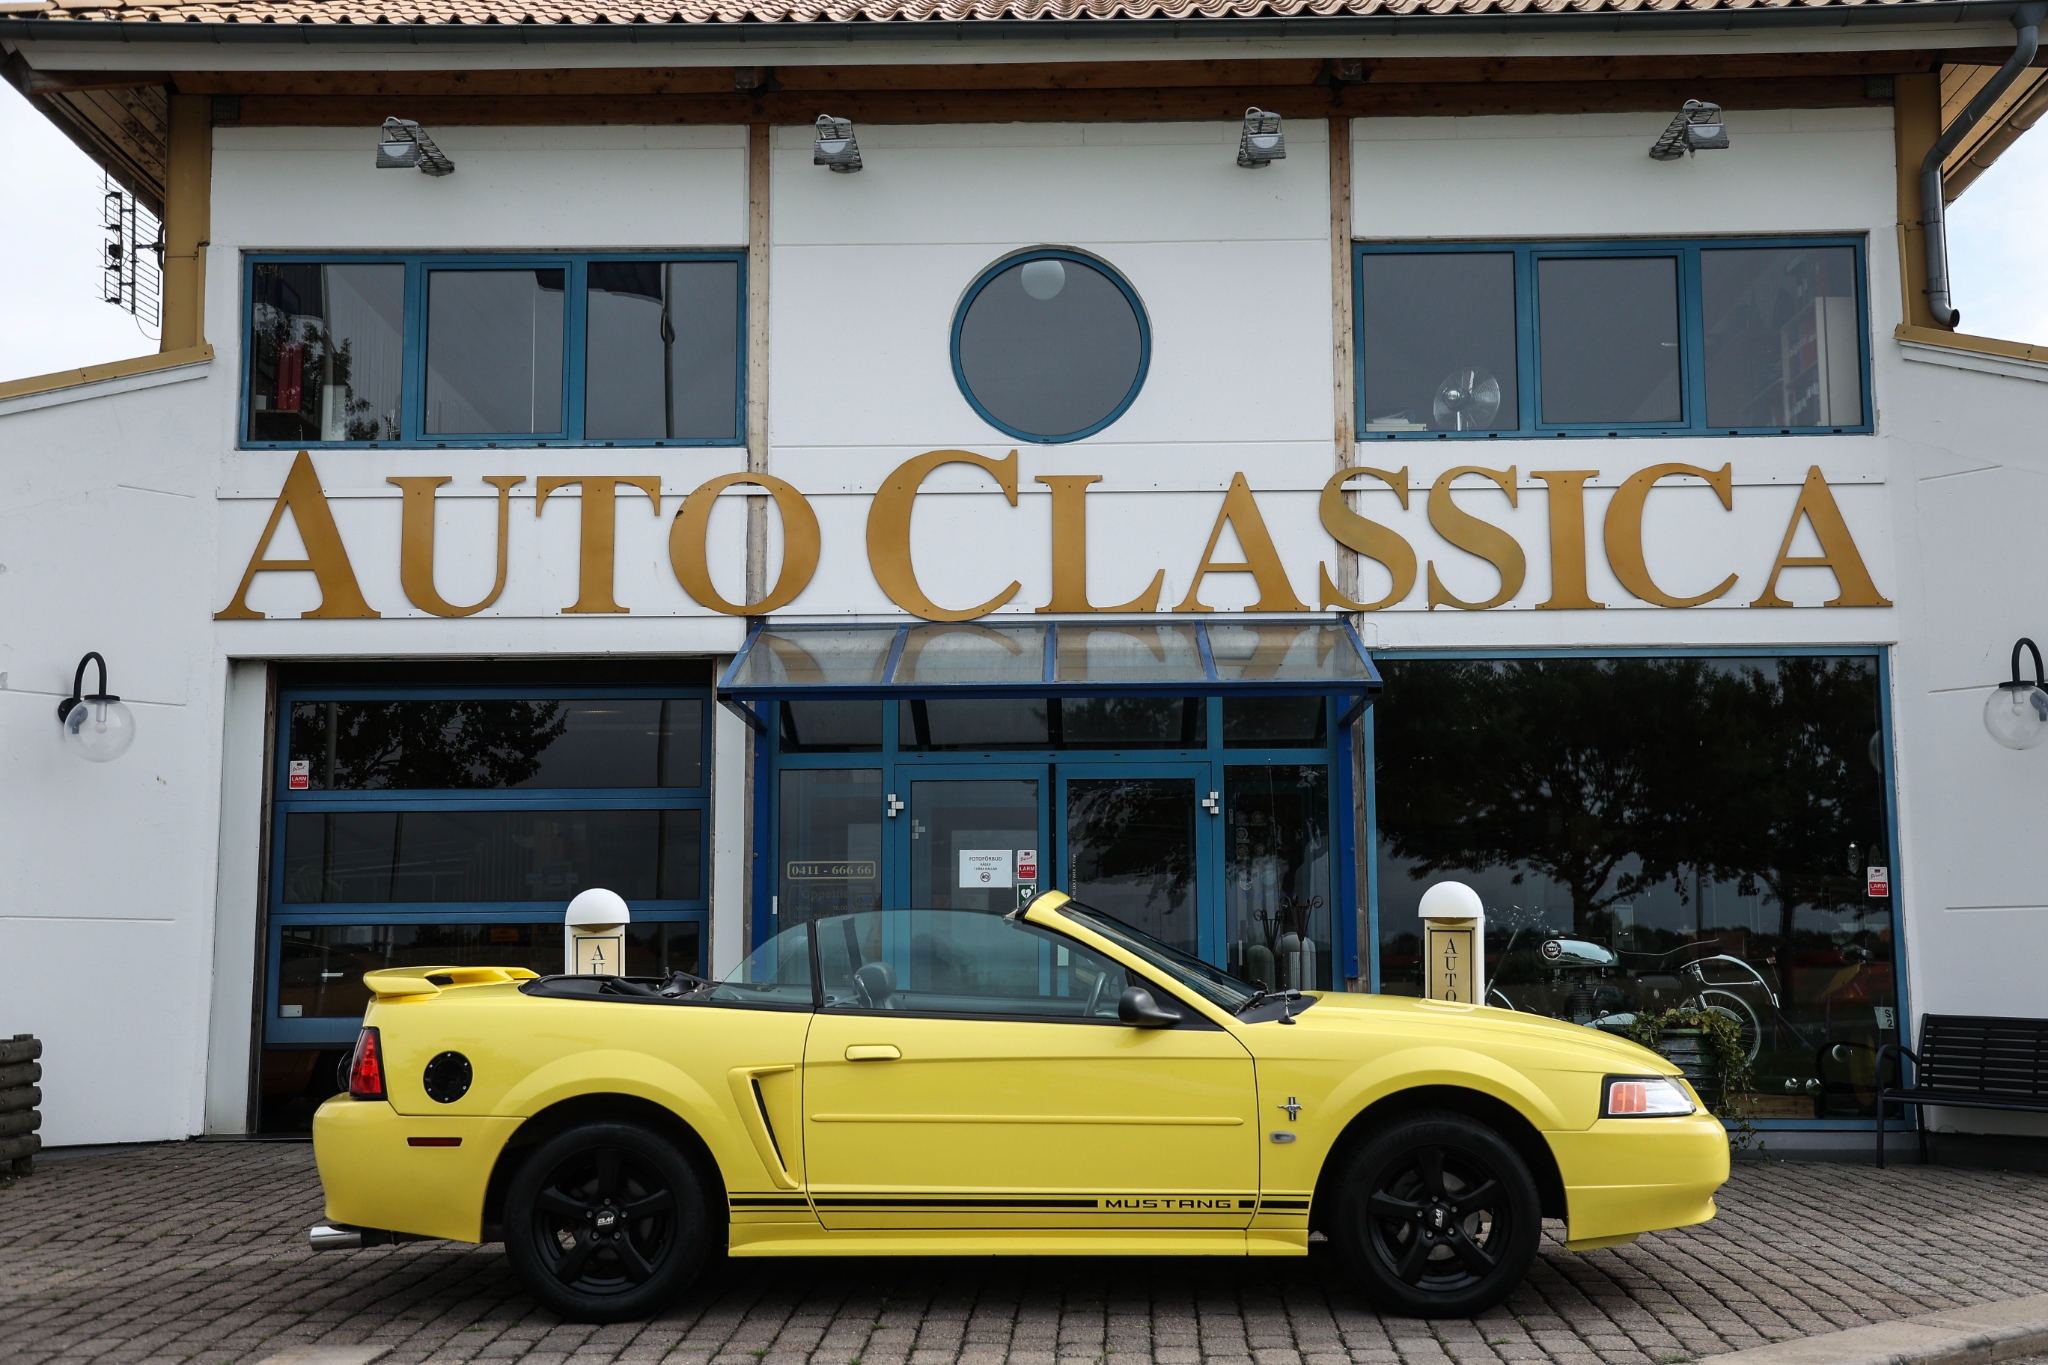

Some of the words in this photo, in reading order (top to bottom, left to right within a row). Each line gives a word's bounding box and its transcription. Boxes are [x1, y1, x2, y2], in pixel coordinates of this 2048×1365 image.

[213, 450, 821, 619] AUTO
[866, 449, 1893, 622] CLASSICA
[791, 865, 819, 875] 0411
[831, 865, 854, 875] 666
[857, 865, 872, 875] 66
[1105, 1199, 1232, 1209] MUSTANG
